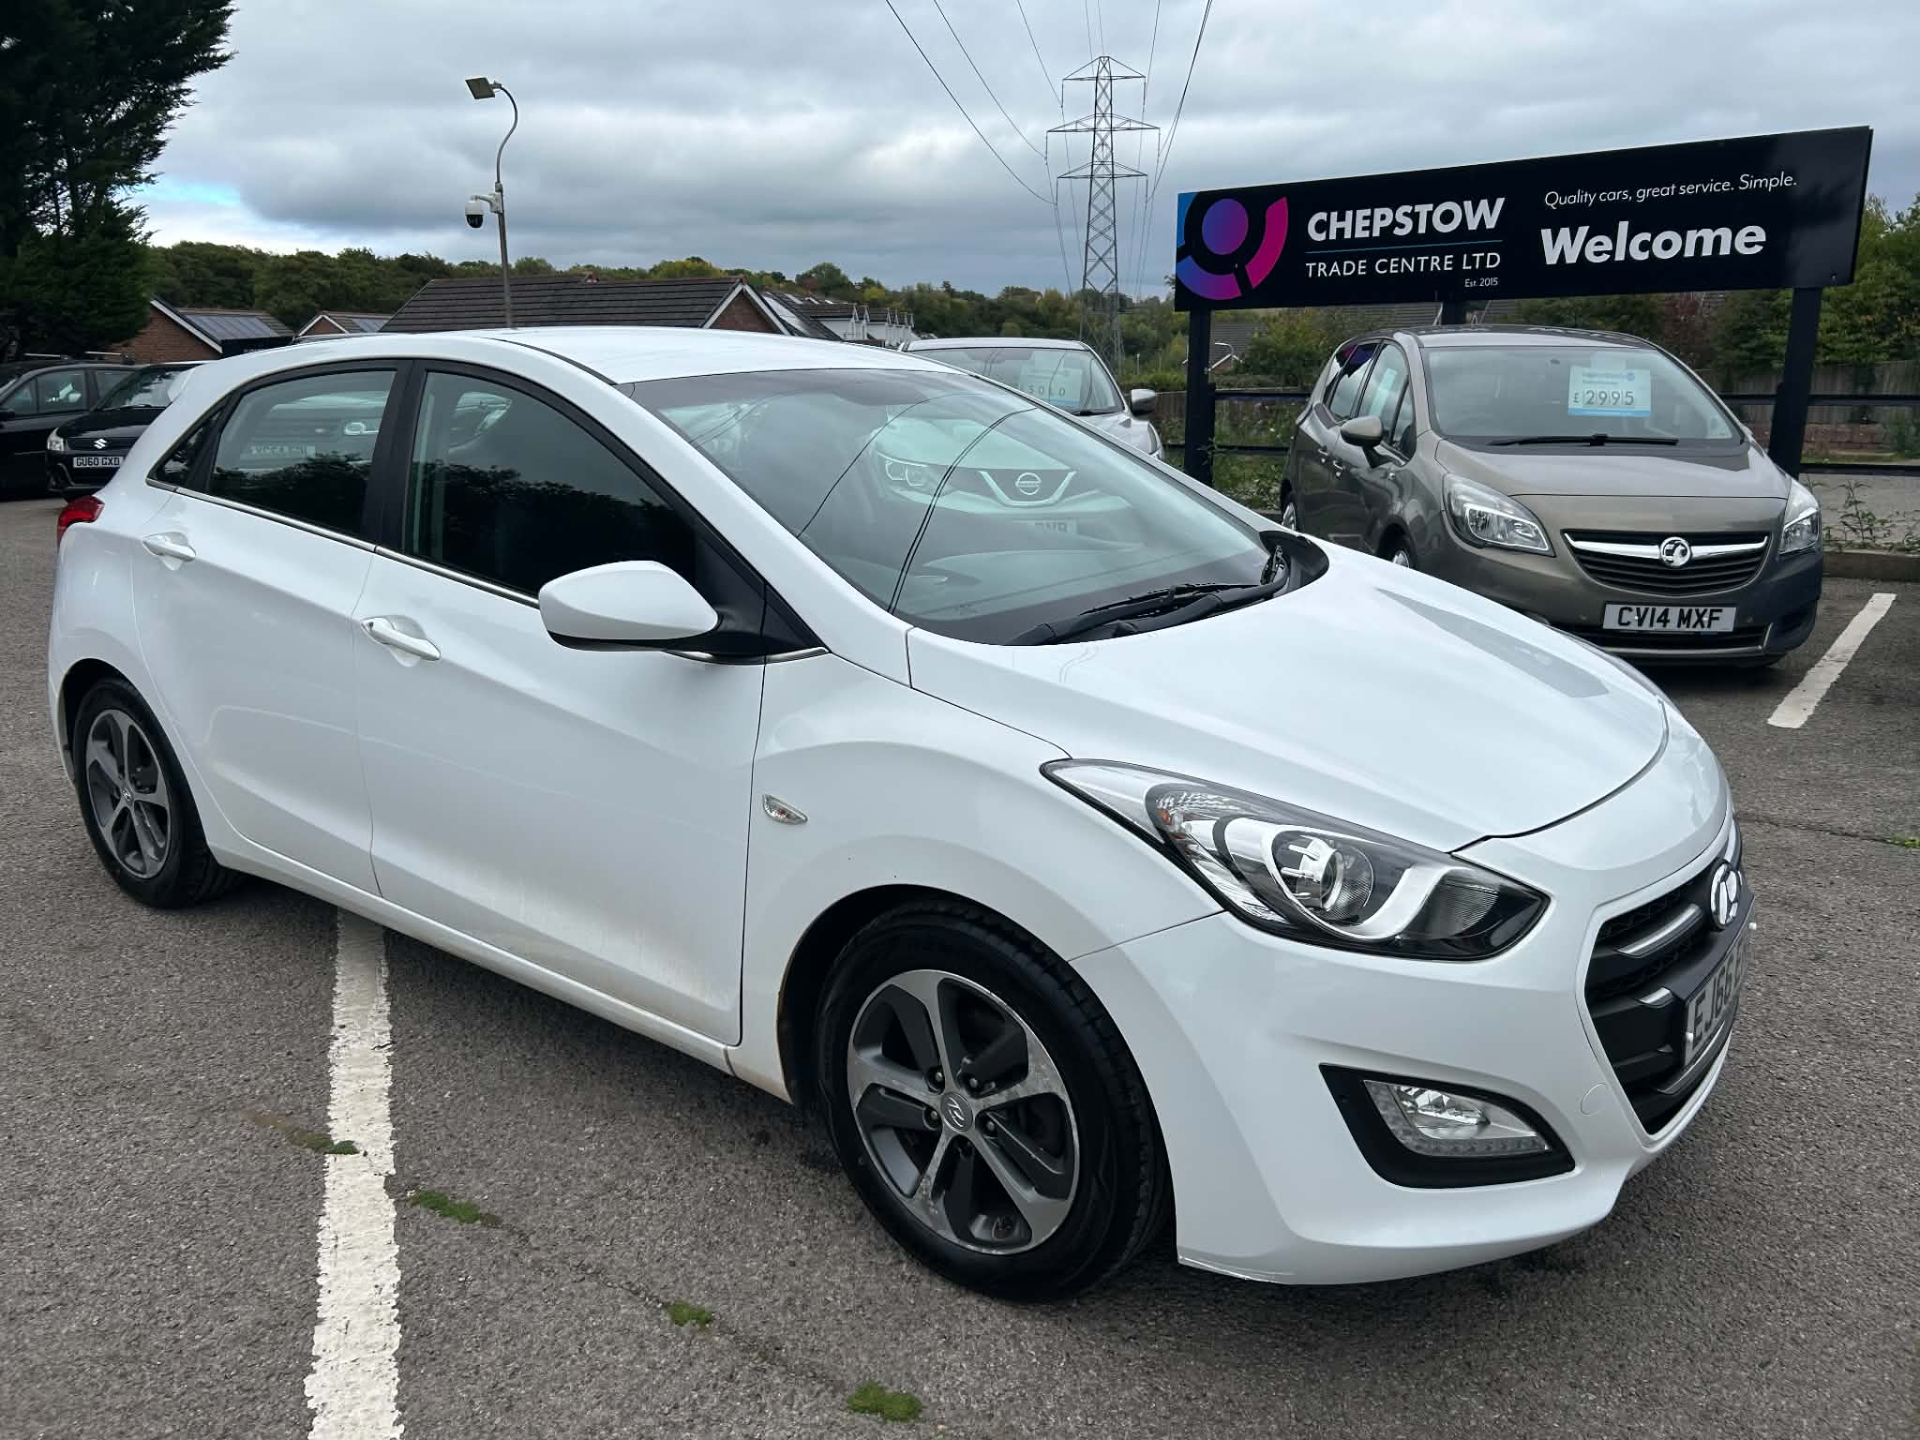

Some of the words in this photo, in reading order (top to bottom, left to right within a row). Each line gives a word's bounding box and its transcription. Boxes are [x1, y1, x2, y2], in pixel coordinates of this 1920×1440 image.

[1544, 190, 1597, 210] Quality
[1599, 188, 1633, 203] cars,
[1636, 183, 1676, 203] great
[1679, 178, 1735, 196] service.
[1738, 171, 1797, 192] Simple.
[1307, 197, 1506, 242] CHEPSTOW
[1540, 220, 1767, 266] Welcome
[1305, 260, 1367, 279] TRADE
[1375, 255, 1454, 275] CENTRE
[1462, 252, 1501, 271] LTD
[1479, 277, 1499, 287] 2015
[76, 457, 100, 467] GU60
[1617, 606, 1670, 628] CV14
[1676, 607, 1723, 629] MXF
